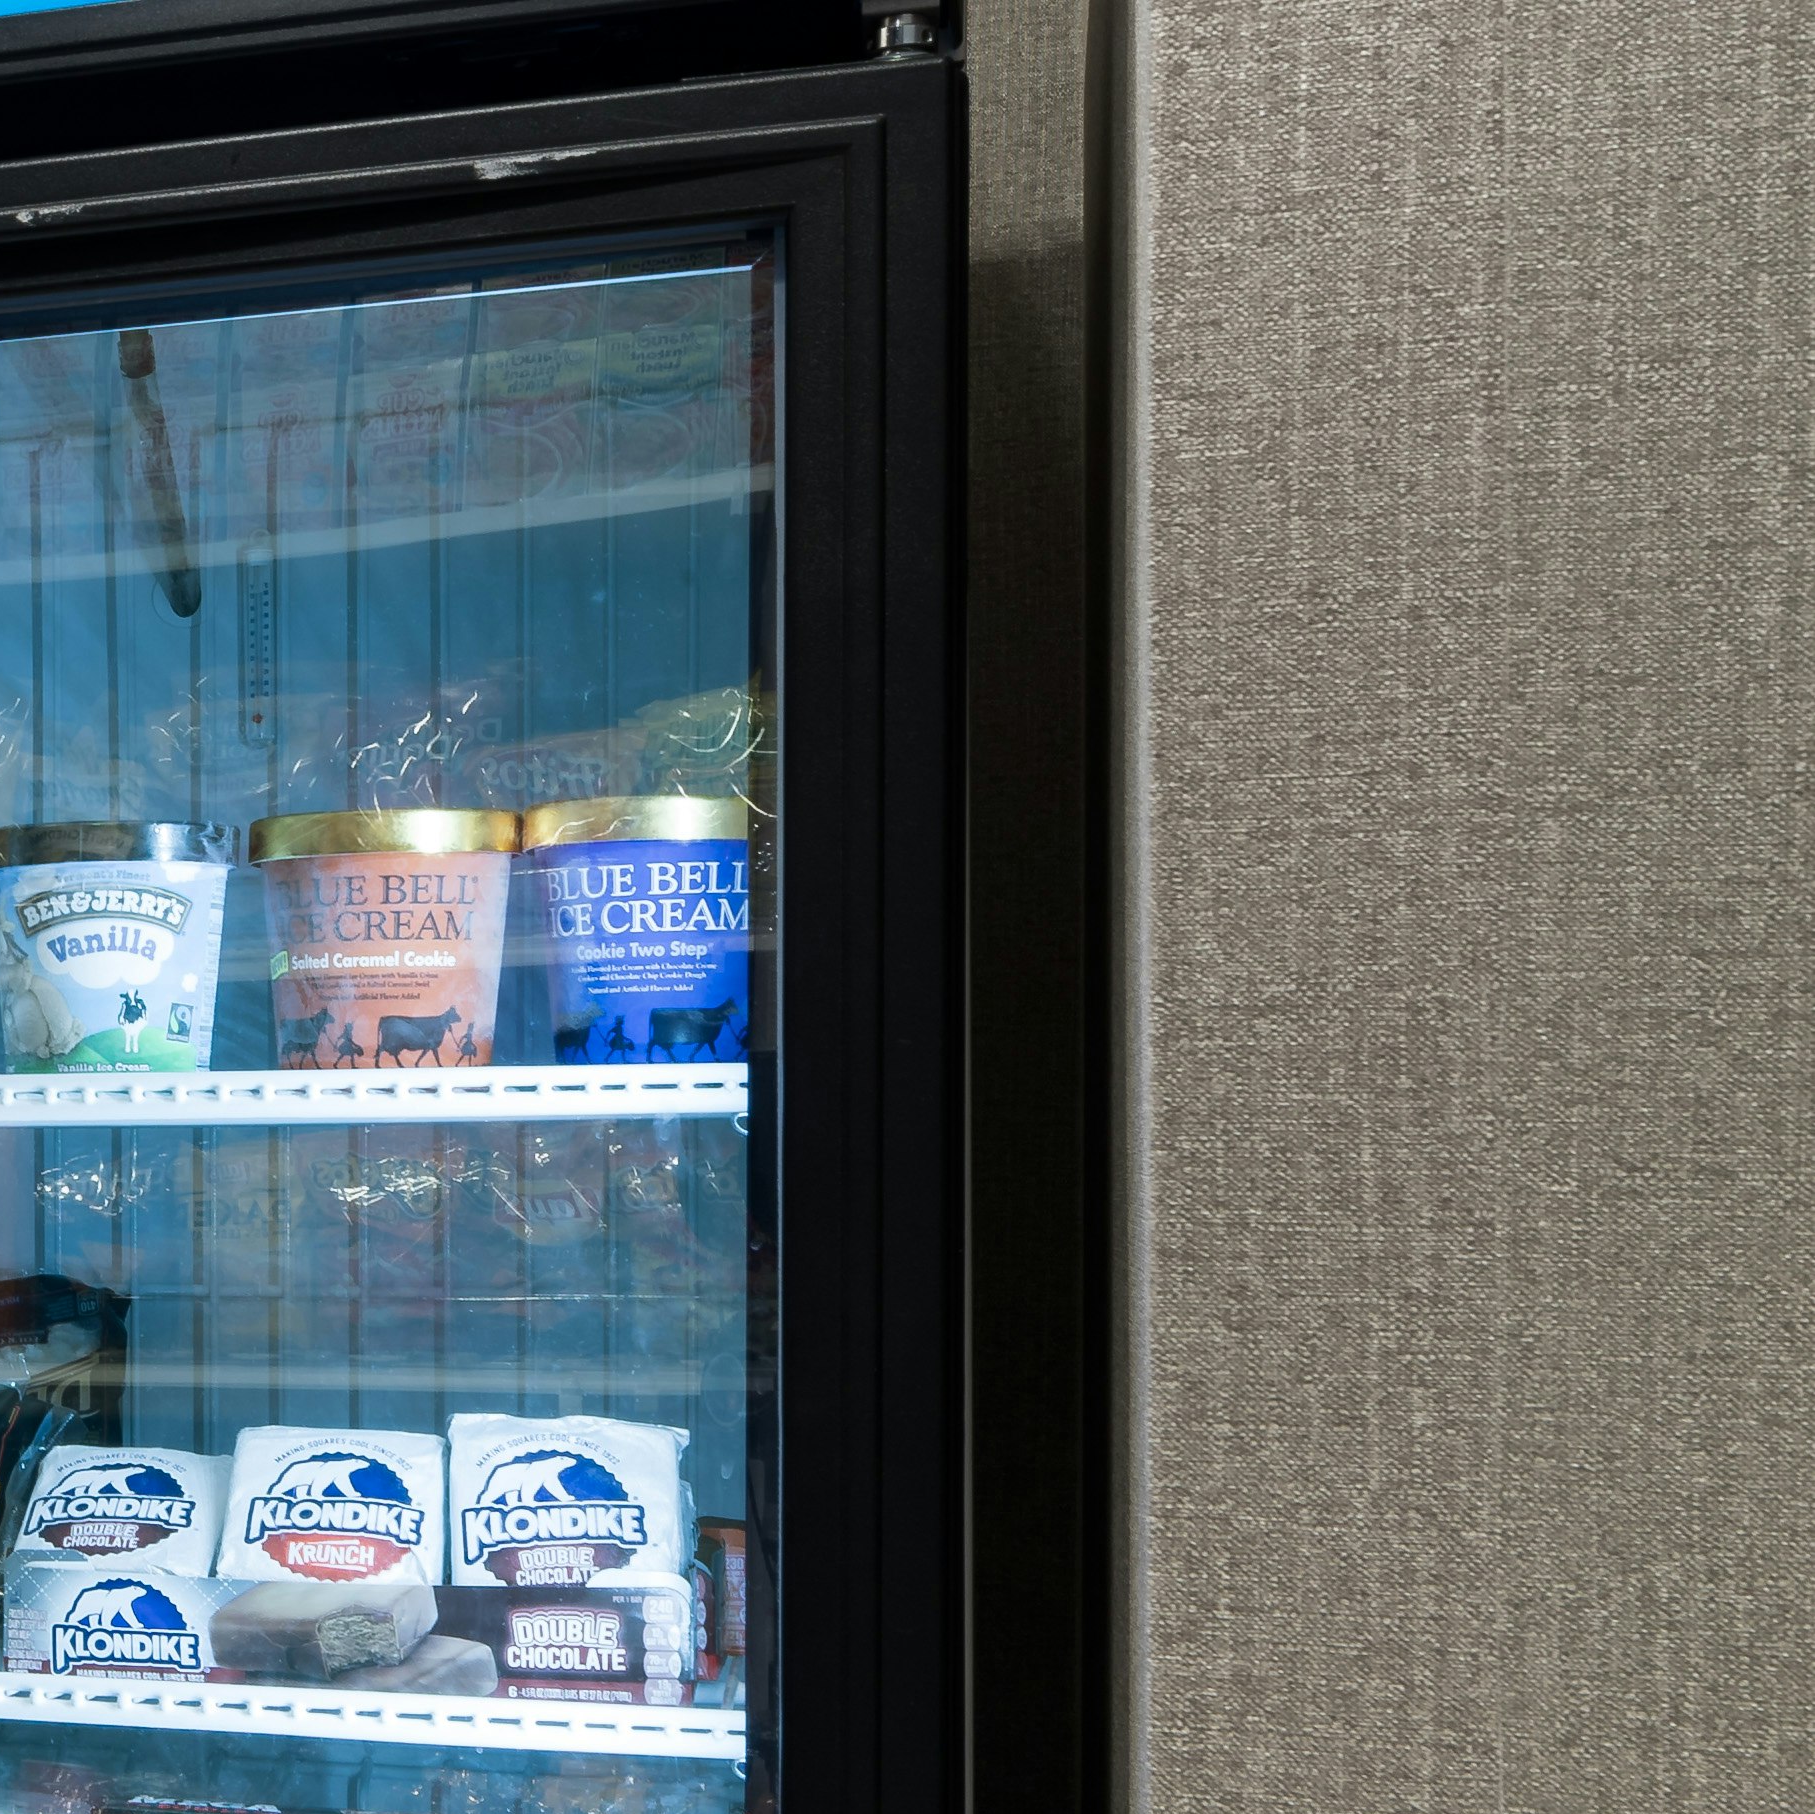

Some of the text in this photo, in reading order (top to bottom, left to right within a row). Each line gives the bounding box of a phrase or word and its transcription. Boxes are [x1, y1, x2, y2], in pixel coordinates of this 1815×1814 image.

[548, 863, 748, 899] BLUE BELL
[550, 901, 748, 936] ICE CREAM
[48, 928, 157, 964] Vanilla
[291, 951, 455, 969] Salted Caramel Cookie
[577, 942, 707, 959] Cookie Two Step
[26, 1496, 194, 1536] KLONDIKE
[246, 1499, 423, 1543] KLONDIKE
[288, 1542, 375, 1564] KRUNCH
[517, 1548, 593, 1567] DOUBLE
[516, 1616, 617, 1645] DOUBLE
[52, 1628, 200, 1675] KLONDIKE
[507, 1645, 626, 1671] CHOCOLATE
